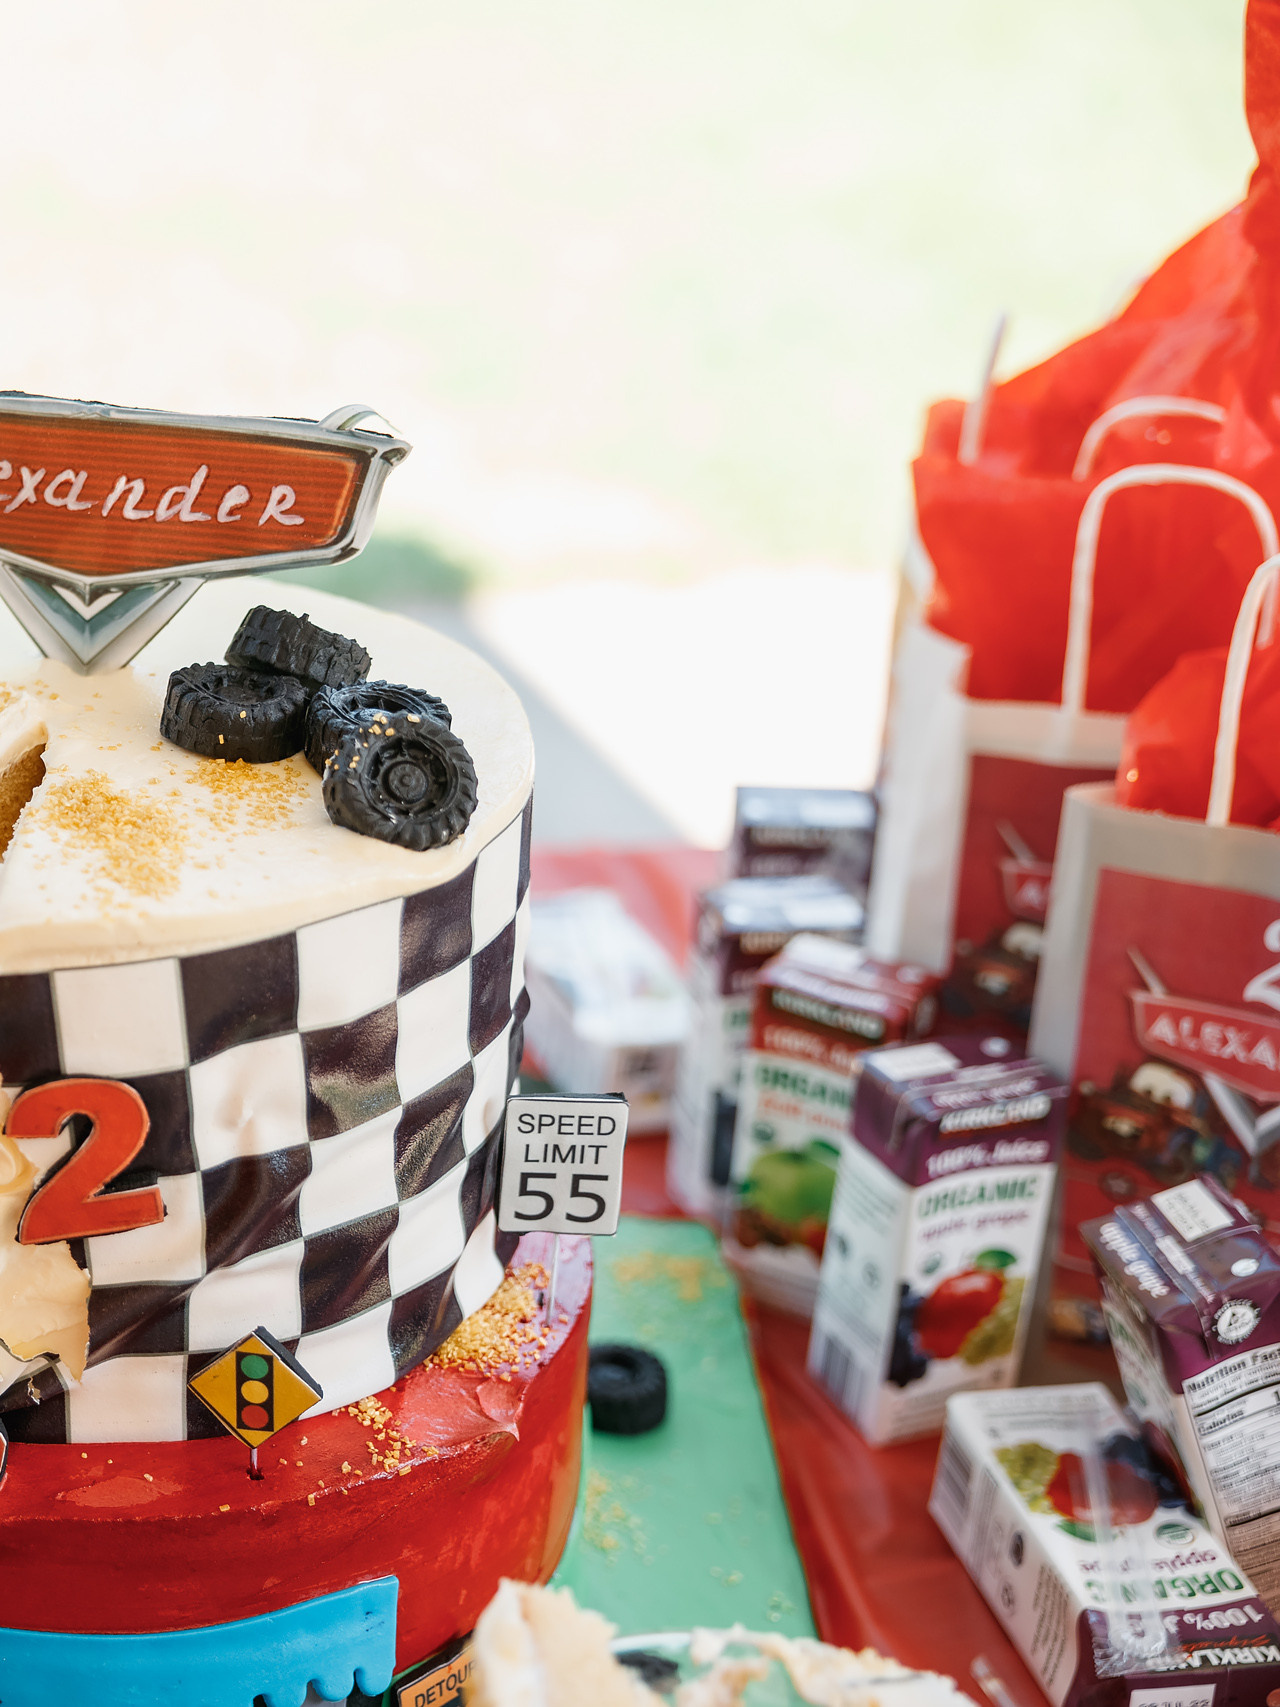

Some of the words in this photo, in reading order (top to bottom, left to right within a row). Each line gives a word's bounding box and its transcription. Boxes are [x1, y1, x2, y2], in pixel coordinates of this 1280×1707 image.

[1144, 1010, 1280, 1071] ALEXA
[756, 1063, 851, 1111] ORGAN
[517, 1113, 616, 1136] SPEED
[6, 1077, 165, 1246] 2
[524, 1143, 608, 1165] LIMIT
[514, 1172, 609, 1223] 55
[920, 1176, 1038, 1217] ORGANIC
[1153, 1550, 1217, 1573] apple
[1084, 1568, 1244, 1603] ORGANC
[1182, 1604, 1265, 1630] 100%
[1146, 1644, 1280, 1672] KIRKLA
